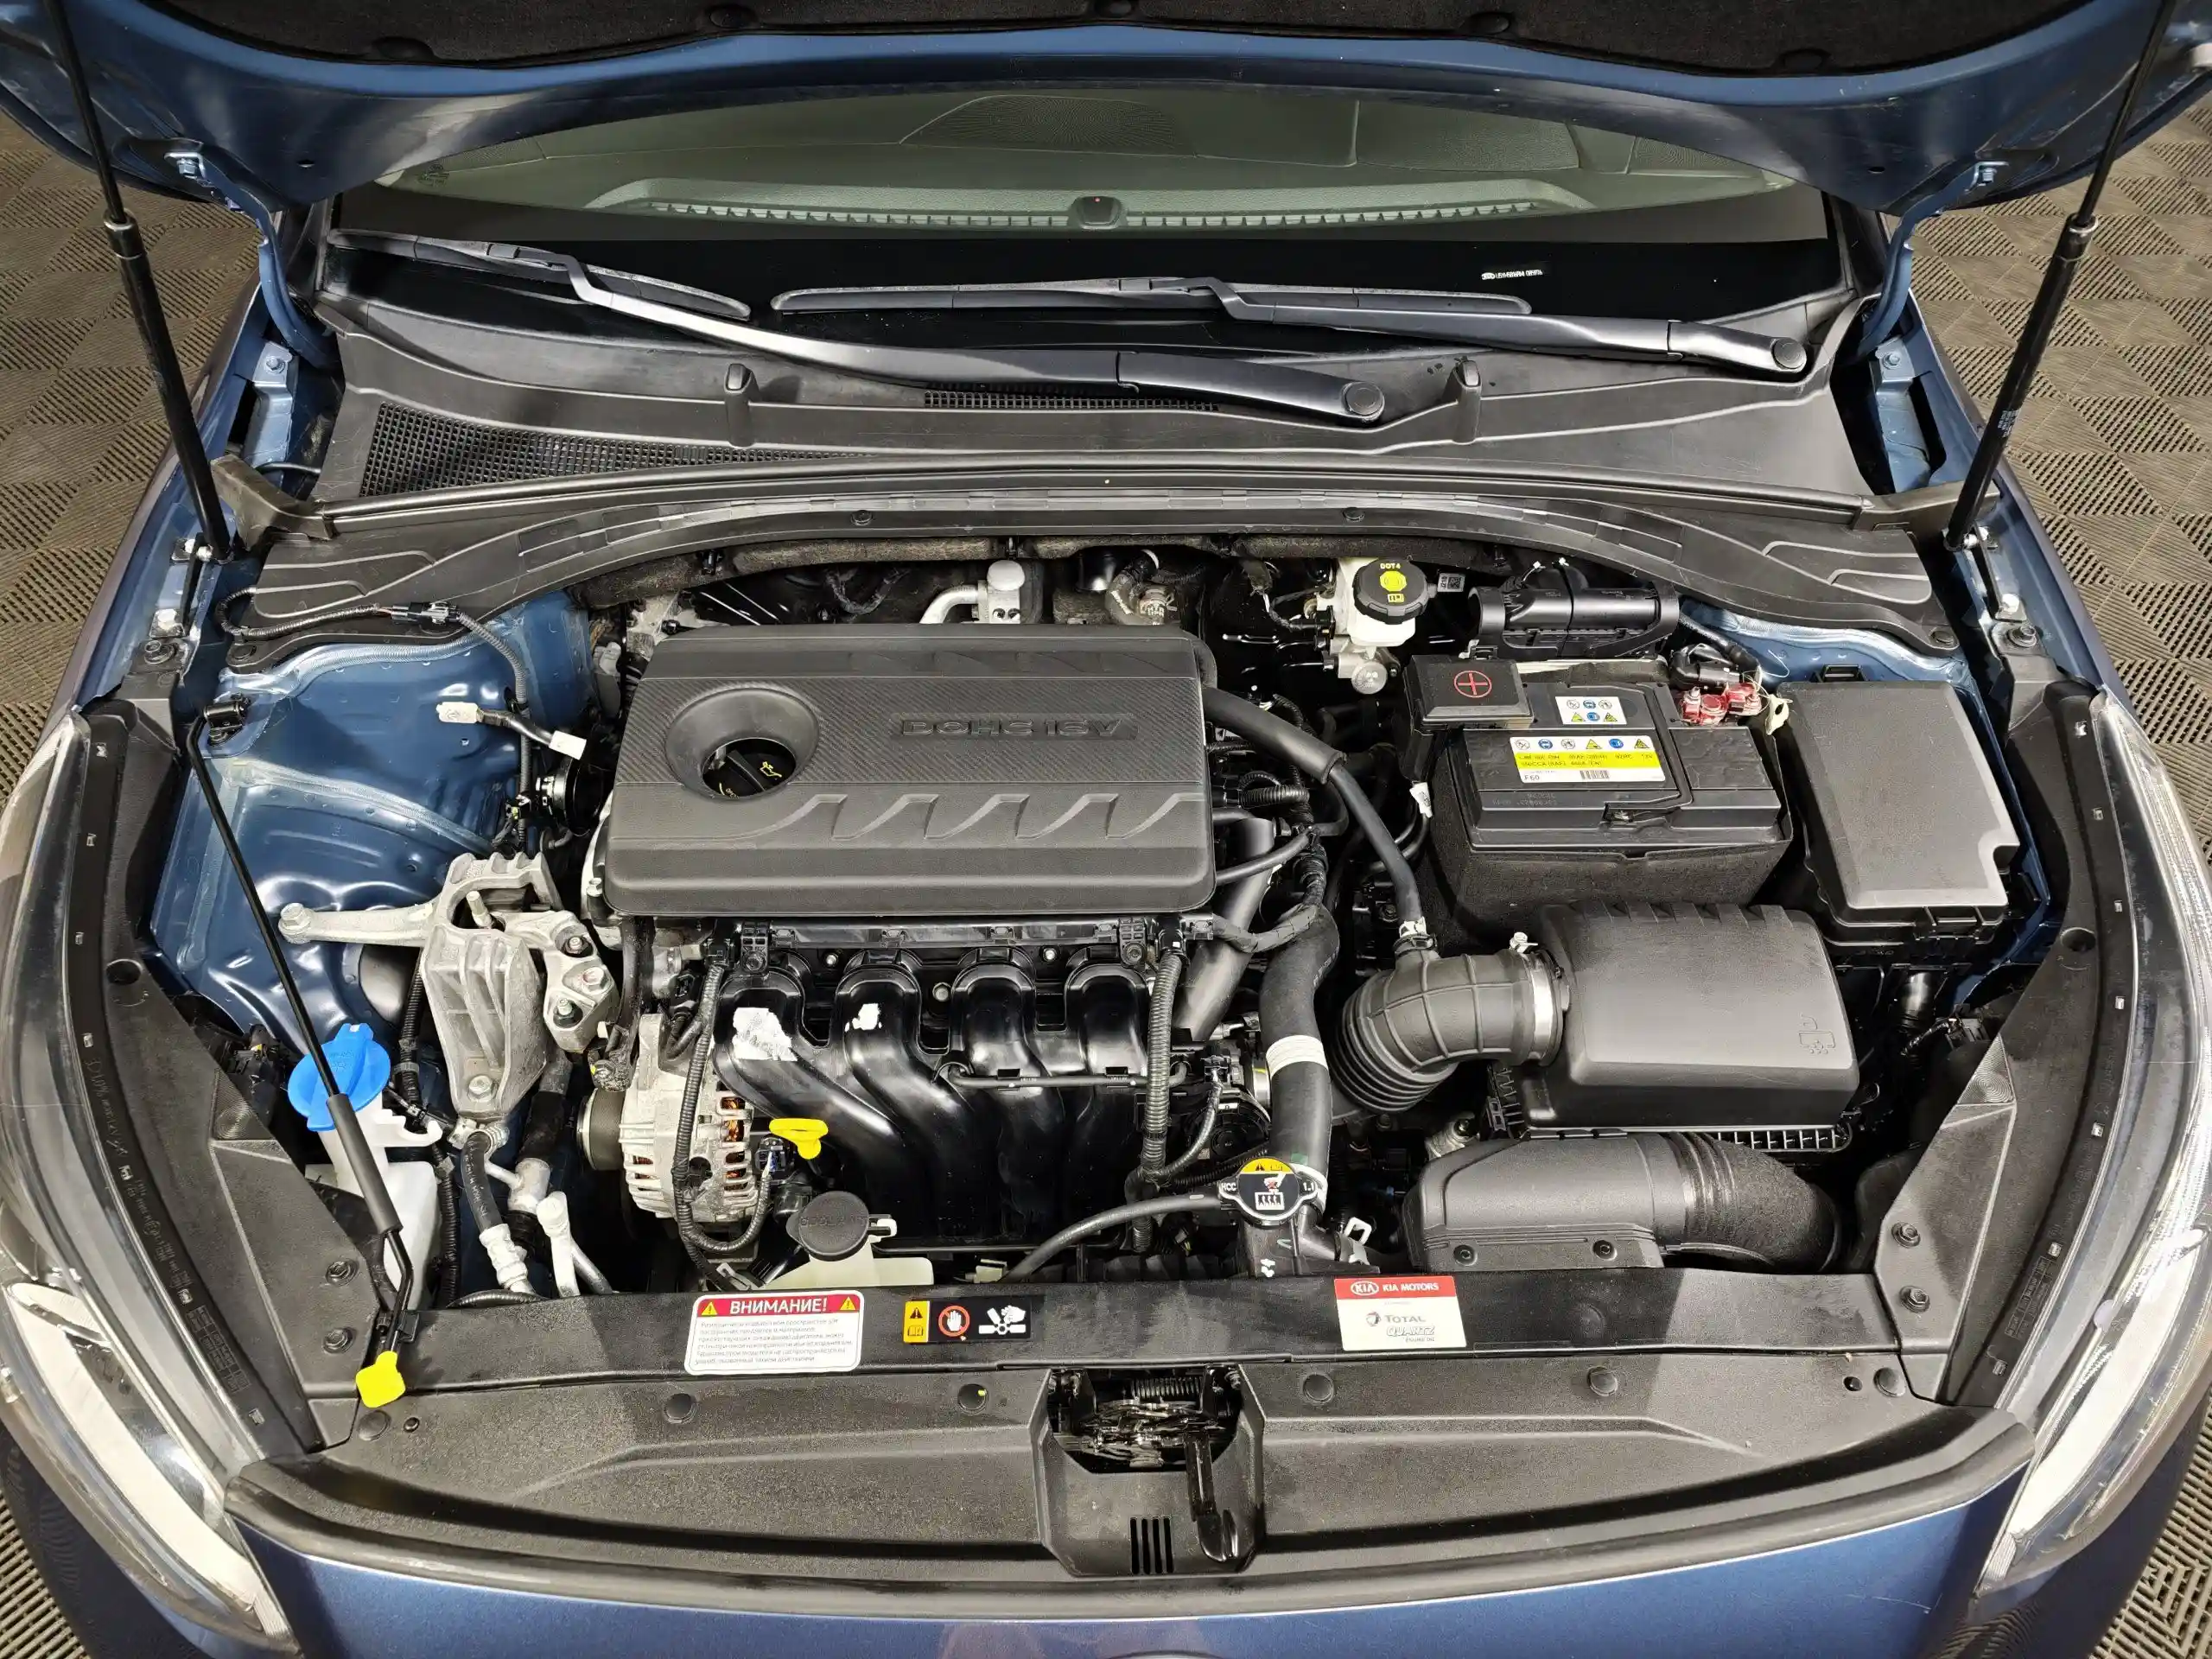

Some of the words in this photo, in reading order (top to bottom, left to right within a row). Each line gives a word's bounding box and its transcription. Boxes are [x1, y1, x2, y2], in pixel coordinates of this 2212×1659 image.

[901, 718, 1034, 736] DOHC
[1044, 718, 1122, 736] 16V
[1302, 1182, 1314, 1192] 1.1
[1352, 1282, 1378, 1294] KIA
[1382, 1283, 1400, 1292] KIA
[1400, 1282, 1440, 1292] MOTORS
[729, 1298, 828, 1315] ВНИМАНИЕ!
[1386, 1325, 1435, 1337] QUARTZ
